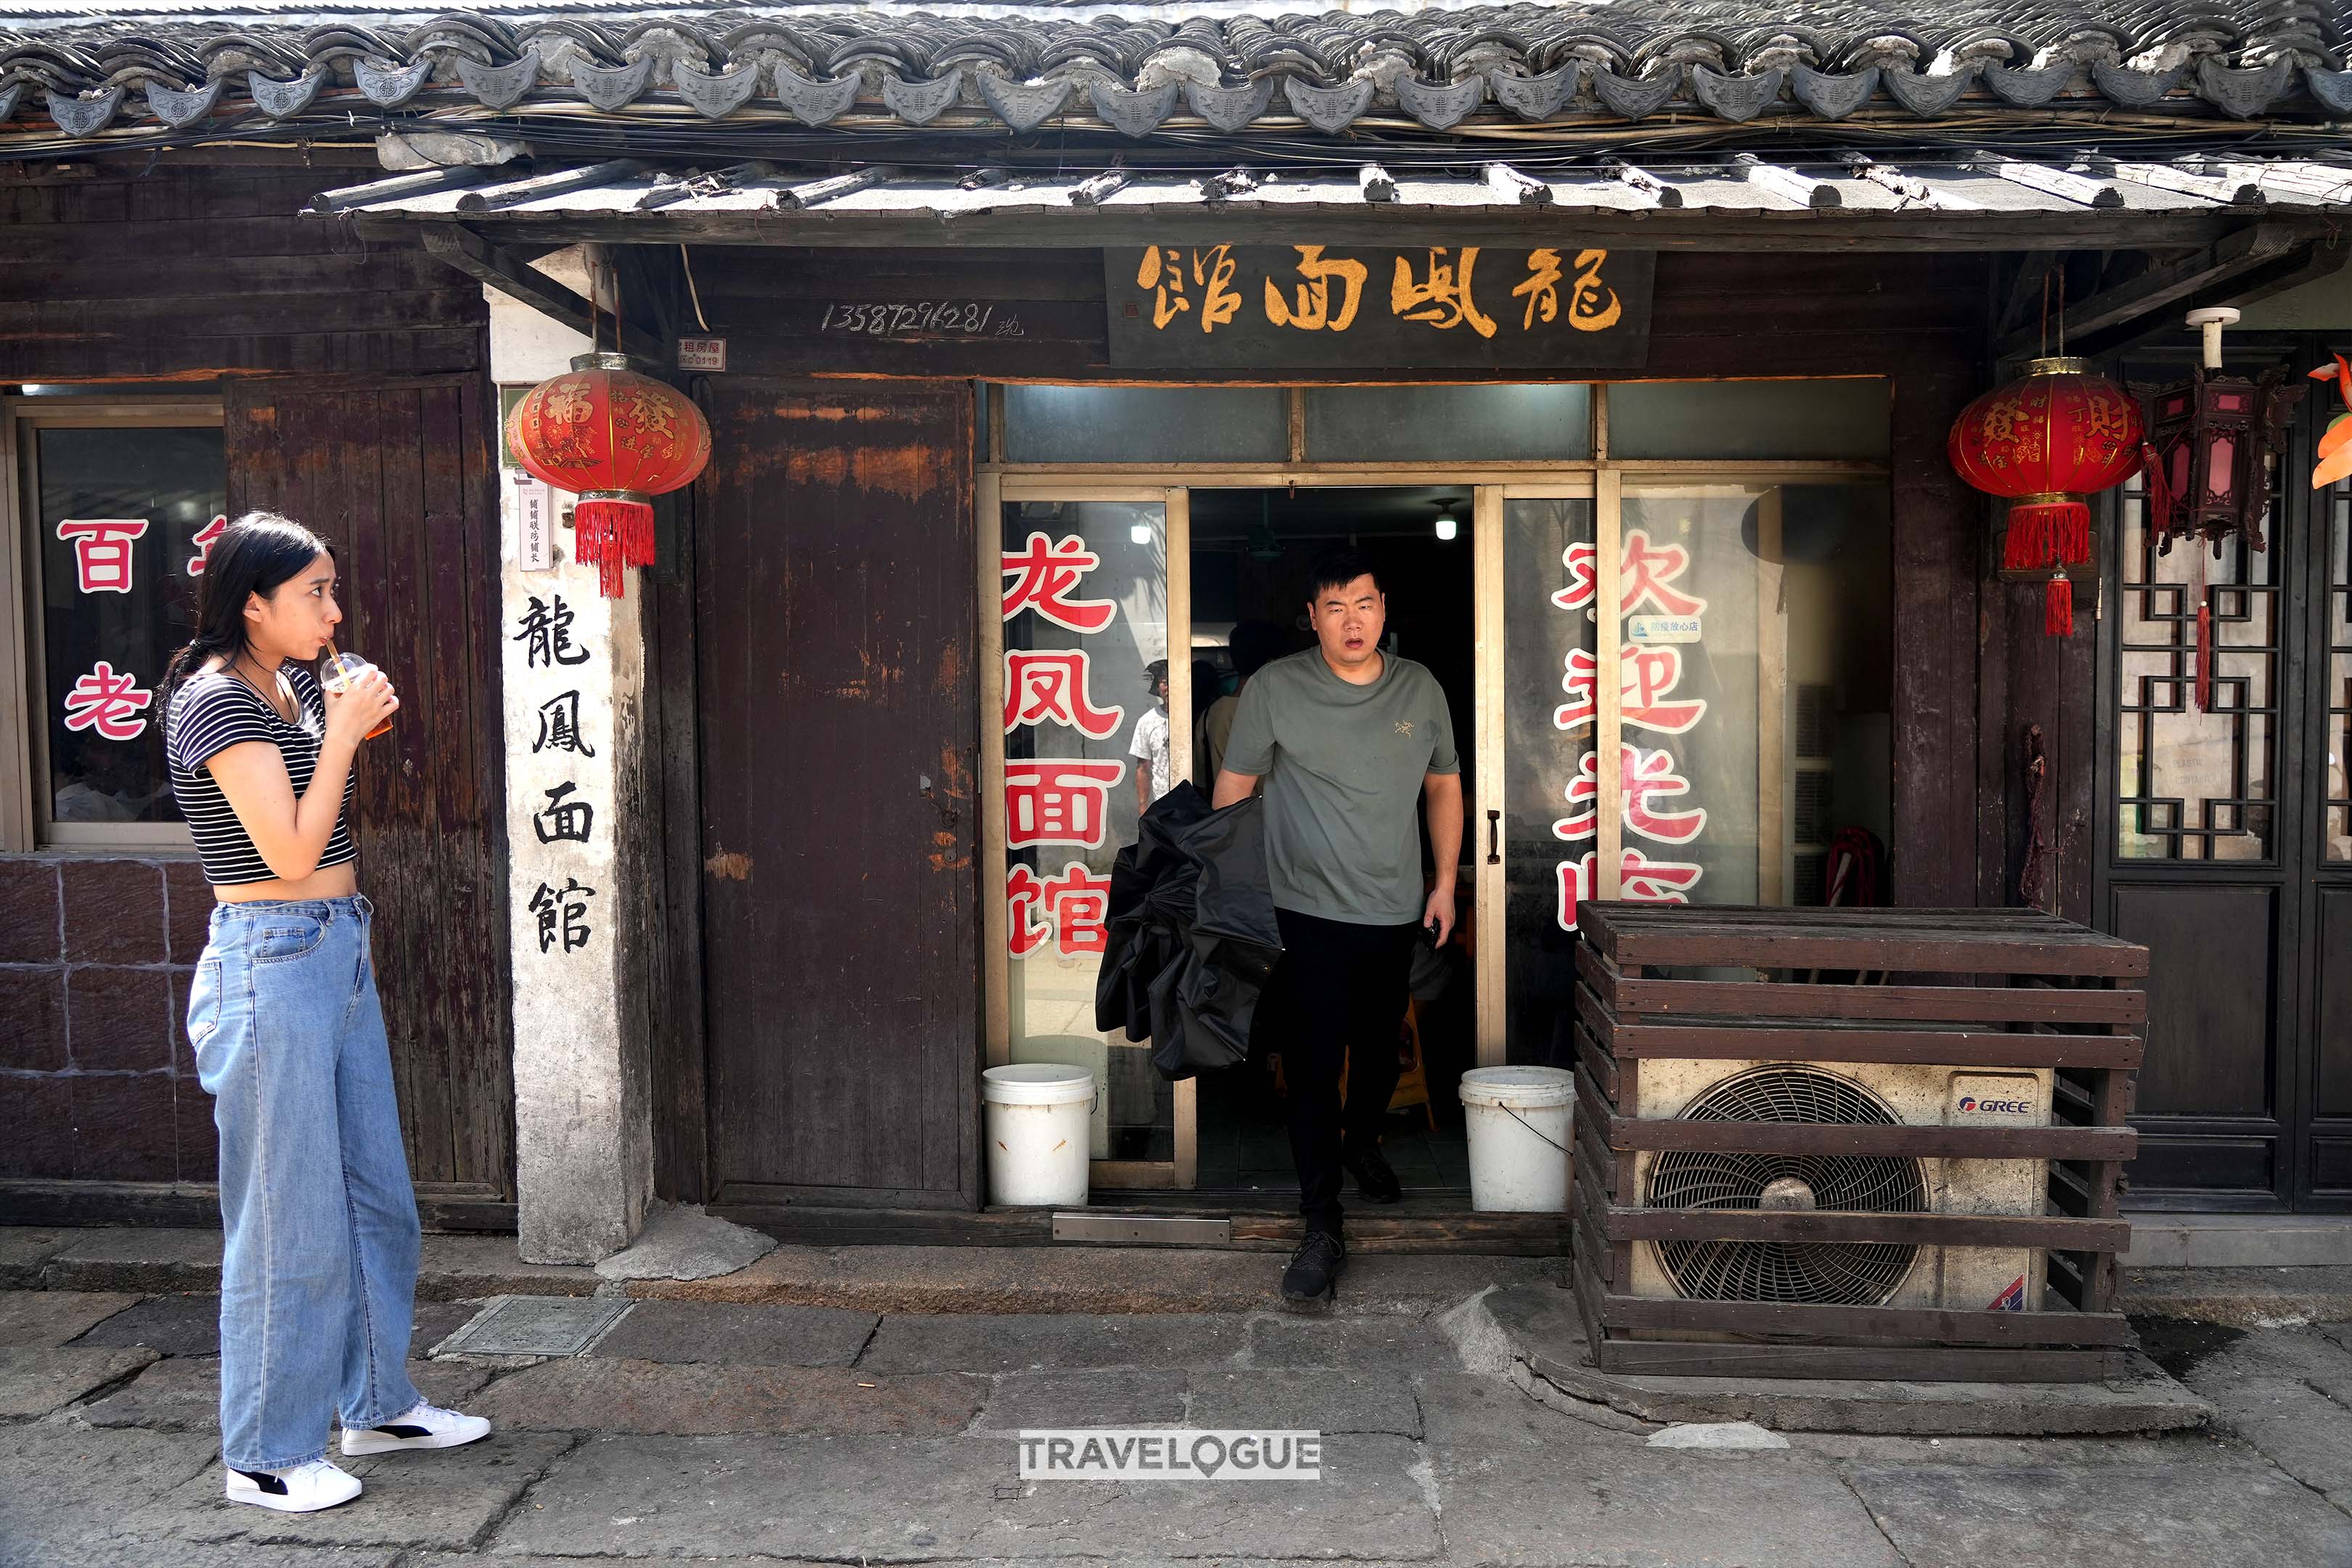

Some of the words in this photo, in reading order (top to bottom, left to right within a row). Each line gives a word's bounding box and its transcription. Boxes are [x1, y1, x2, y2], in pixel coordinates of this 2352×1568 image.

[821, 301, 994, 335] 13587296281
[679, 342, 719, 354] 租房屋
[544, 383, 594, 425] 福
[1650, 621, 1699, 632] 防疫放心店
[1003, 531, 1125, 960] 龙凤面馆
[513, 594, 596, 955] 龍鳳面館
[1980, 1101, 2031, 1113] GREE
